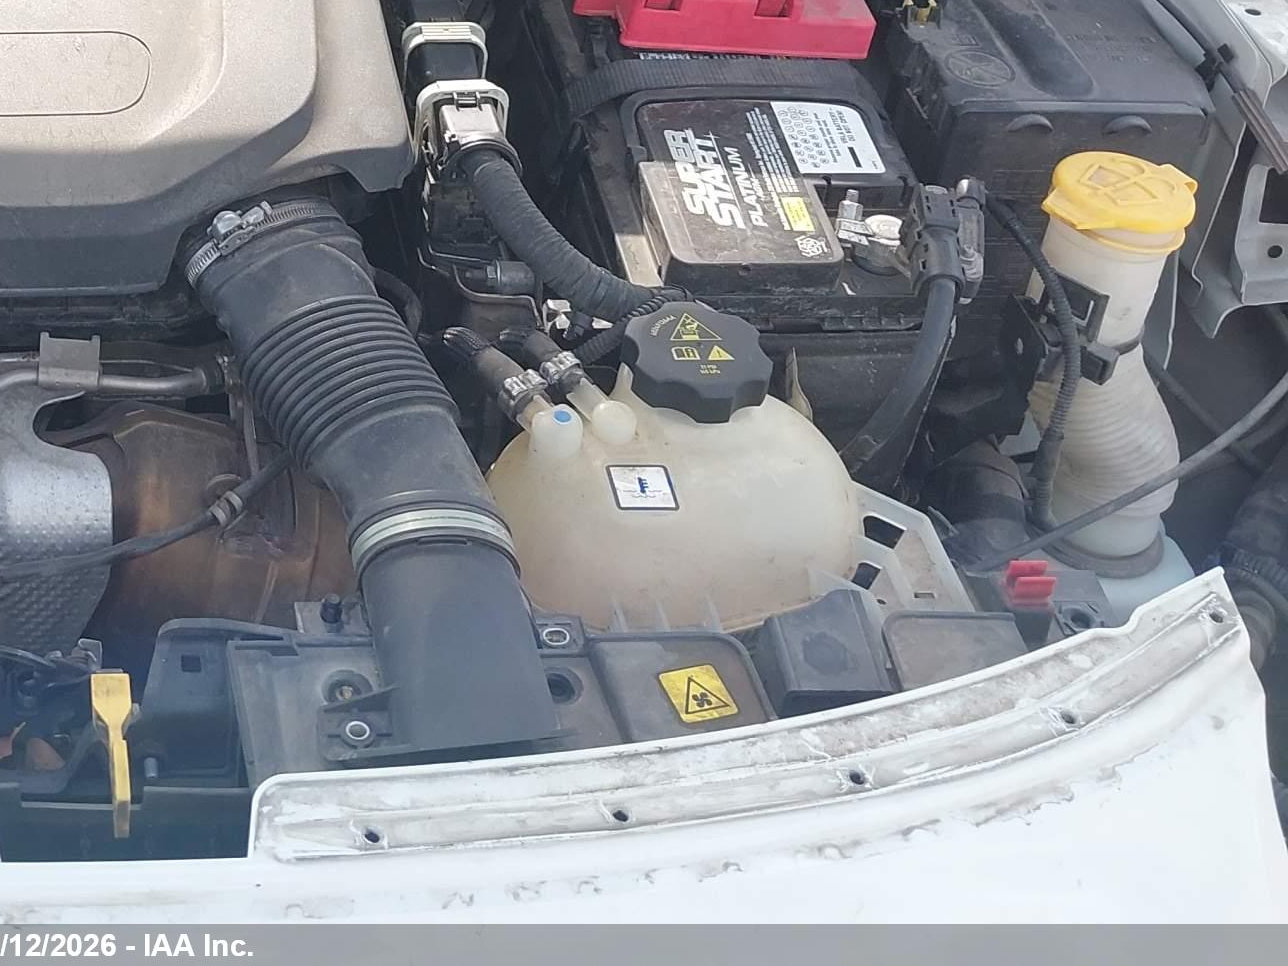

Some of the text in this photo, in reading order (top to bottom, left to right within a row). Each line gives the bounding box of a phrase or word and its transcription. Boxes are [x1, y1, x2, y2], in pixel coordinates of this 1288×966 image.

[664, 129, 706, 215] SUPER
[685, 128, 747, 229] START
[723, 146, 769, 227] PLATINUM
